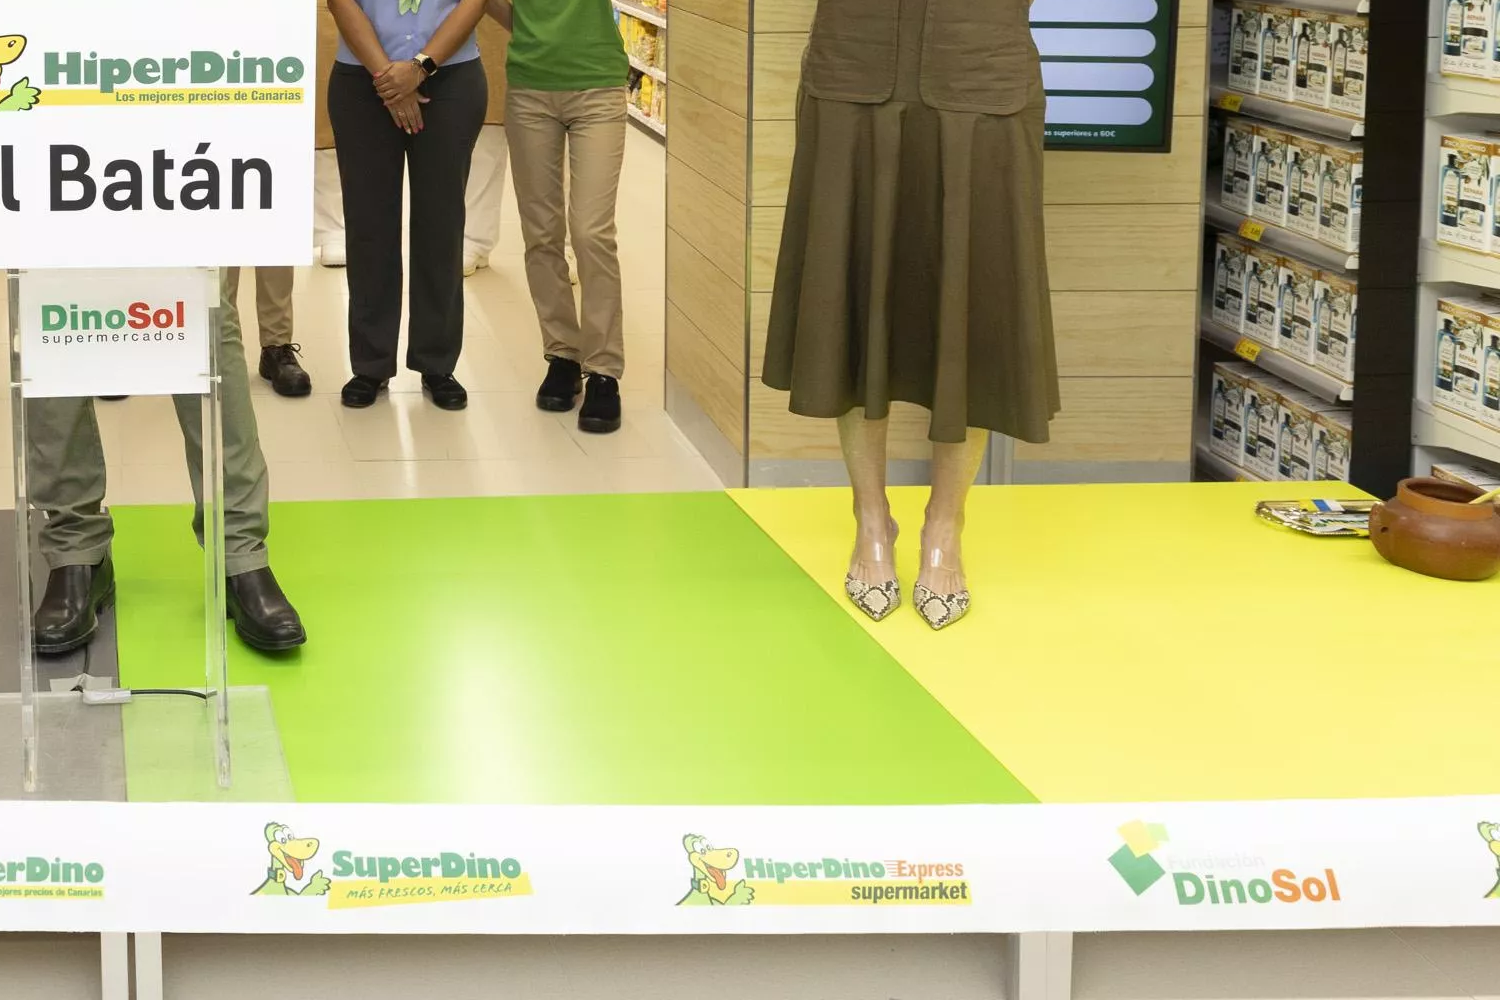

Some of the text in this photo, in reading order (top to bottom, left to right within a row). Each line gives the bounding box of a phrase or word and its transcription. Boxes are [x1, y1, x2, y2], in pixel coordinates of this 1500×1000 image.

[44, 50, 304, 93] HiperDino
[115, 90, 301, 104] Los mejores precios de Canarias
[49, 142, 273, 212] Batán
[41, 301, 184, 331] DinoSol
[42, 331, 185, 345] supermercados
[332, 850, 521, 883] SuperDino
[744, 858, 963, 884] HiperDino Express
[347, 881, 512, 899] MÁS FRESCOS, MÁS CERCA
[851, 882, 967, 904] supermarket
[1173, 869, 1341, 905] DinoSol
